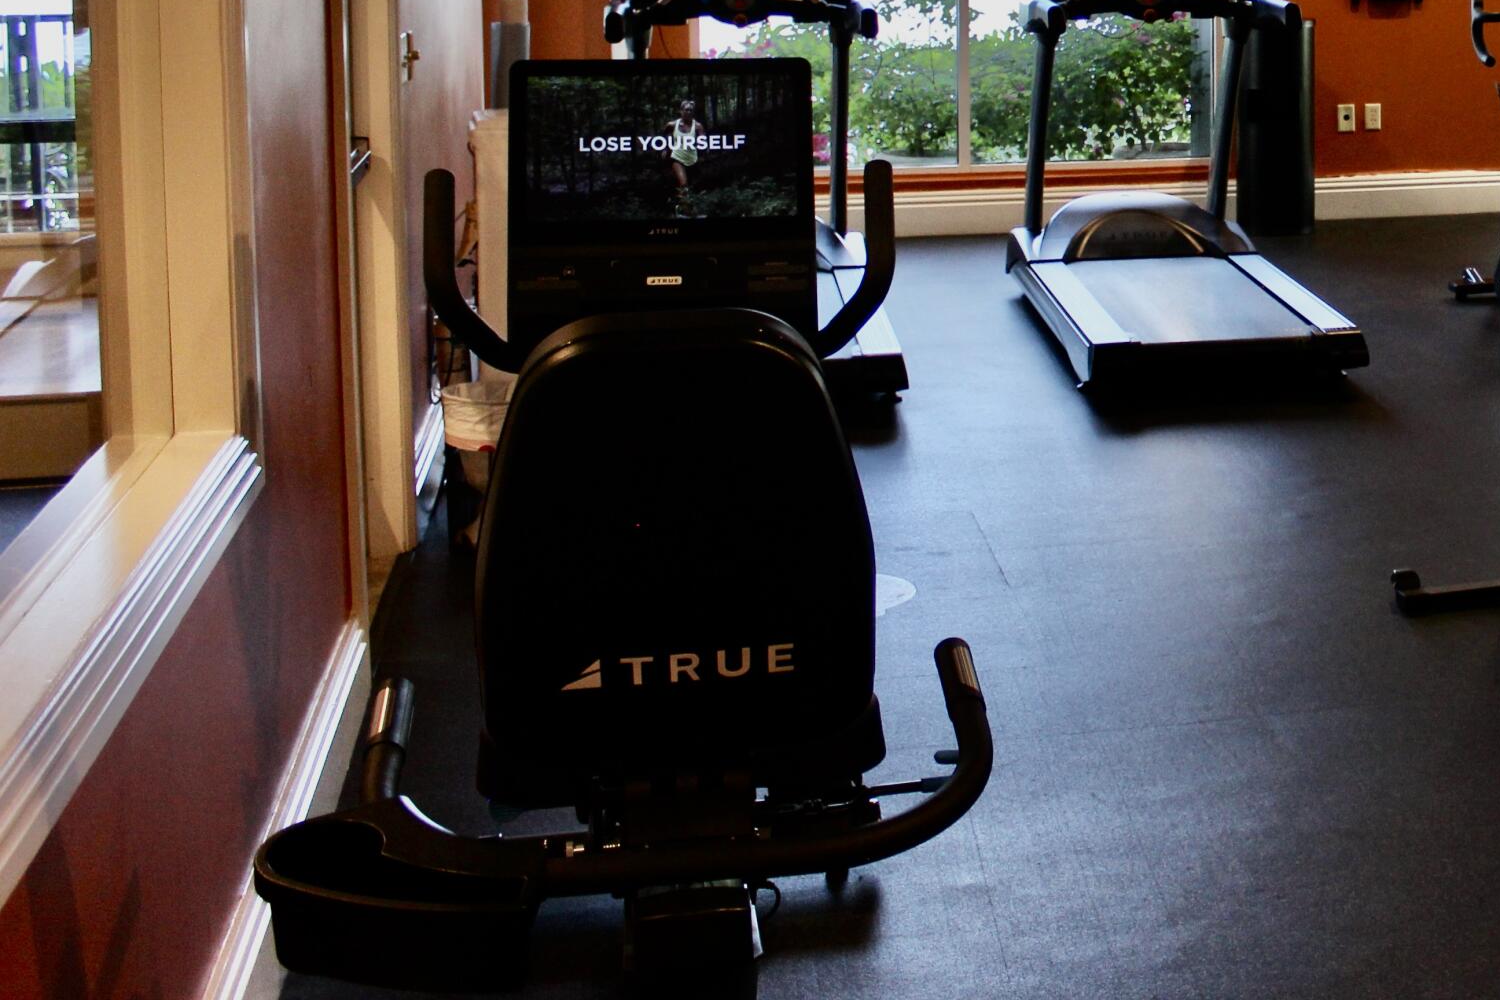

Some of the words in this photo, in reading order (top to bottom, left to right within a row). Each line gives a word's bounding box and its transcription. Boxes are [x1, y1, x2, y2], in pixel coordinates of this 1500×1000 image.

[578, 136, 632, 152] LOSE
[638, 134, 746, 152] YOURSELF
[619, 642, 796, 686] TRUE
